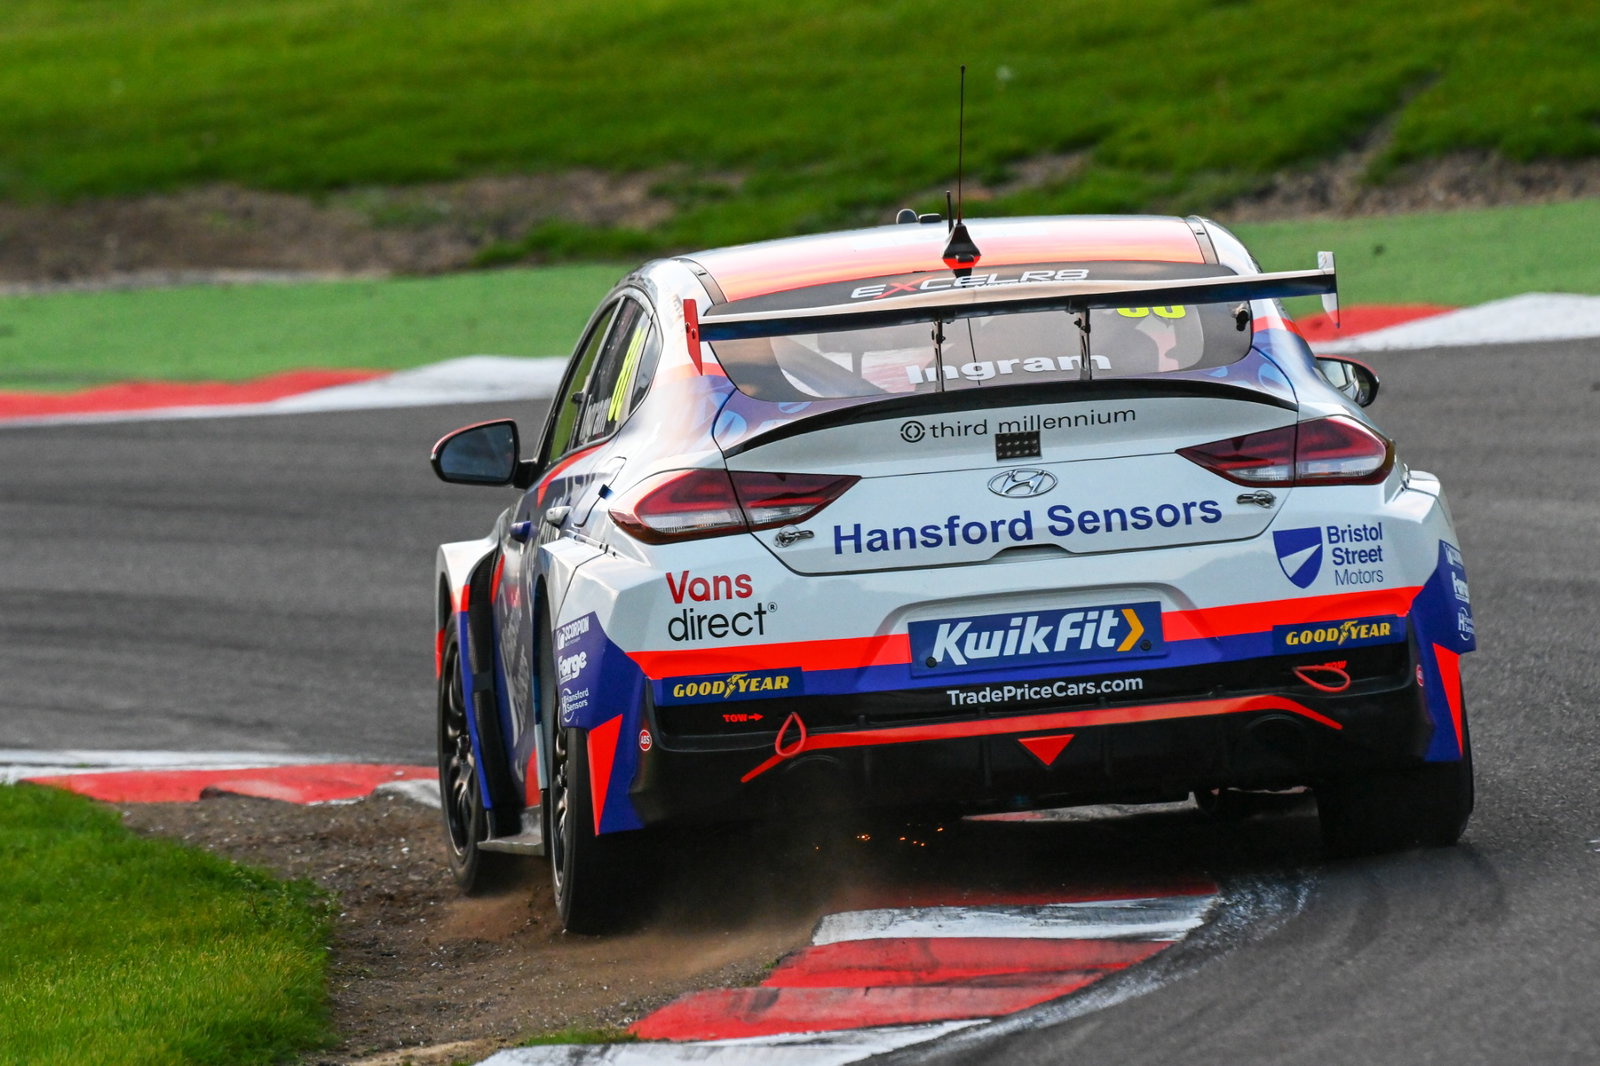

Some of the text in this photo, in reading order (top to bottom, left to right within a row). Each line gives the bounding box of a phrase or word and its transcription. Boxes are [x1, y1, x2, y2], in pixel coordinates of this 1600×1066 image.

[905, 353, 1112, 384] Ingram
[930, 409, 1136, 439] third millennium
[834, 499, 1222, 555] Hansford Sensors
[1326, 522, 1383, 545] Bristol
[1332, 546, 1383, 566] Street
[665, 570, 753, 604] Vans
[1335, 569, 1384, 586] Motors
[1286, 621, 1390, 645] GOODYEAR
[673, 674, 790, 698] GOODYEAR
[947, 677, 1143, 706] TradePriceCars.com
[722, 714, 748, 723] TOW
